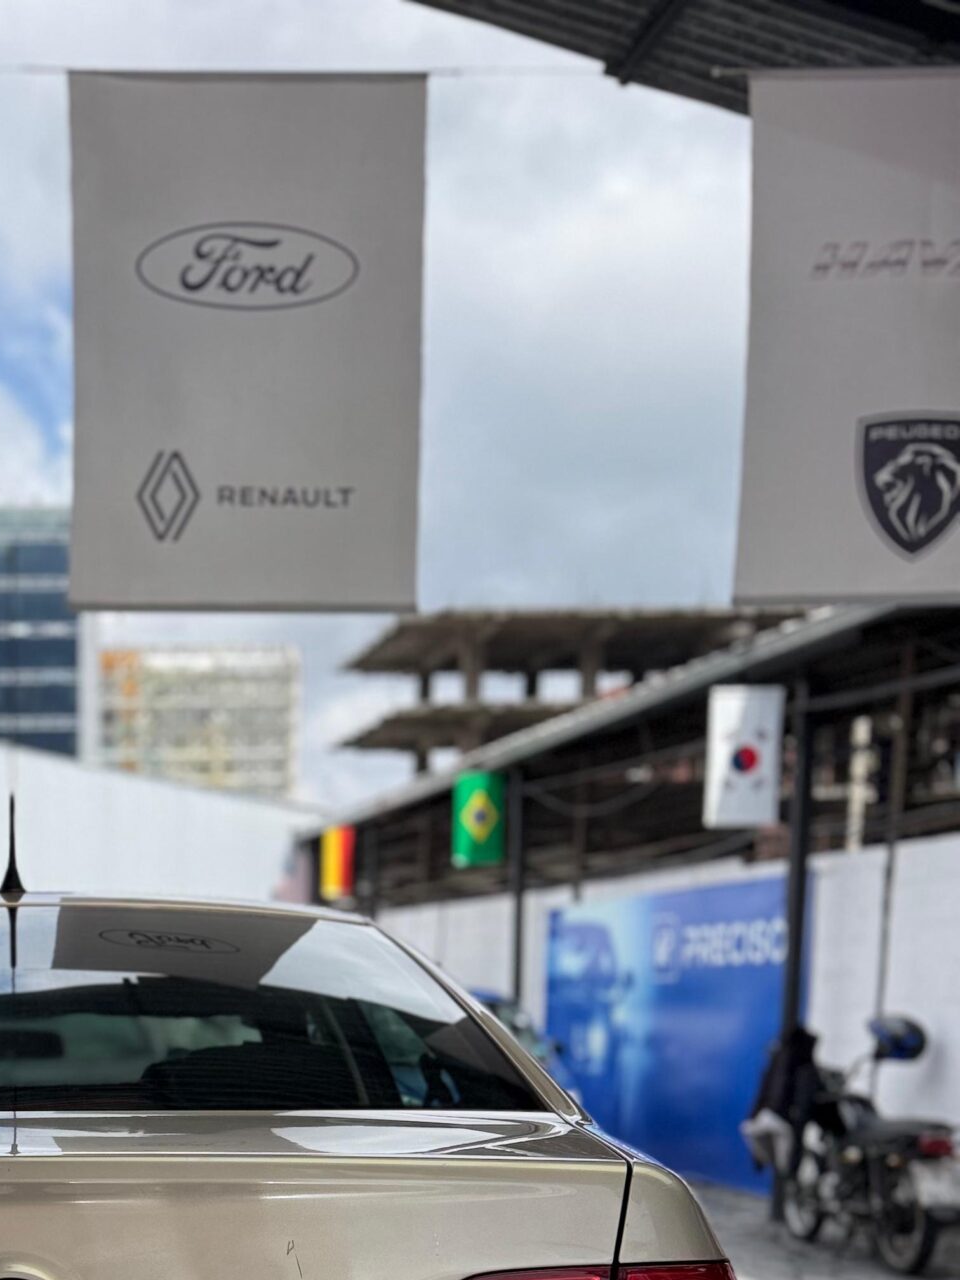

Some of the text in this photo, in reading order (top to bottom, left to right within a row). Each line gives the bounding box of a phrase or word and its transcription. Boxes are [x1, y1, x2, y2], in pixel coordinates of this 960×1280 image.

[179, 233, 316, 296] Ford
[808, 237, 960, 278] HAV
[216, 485, 356, 509] RENAULT
